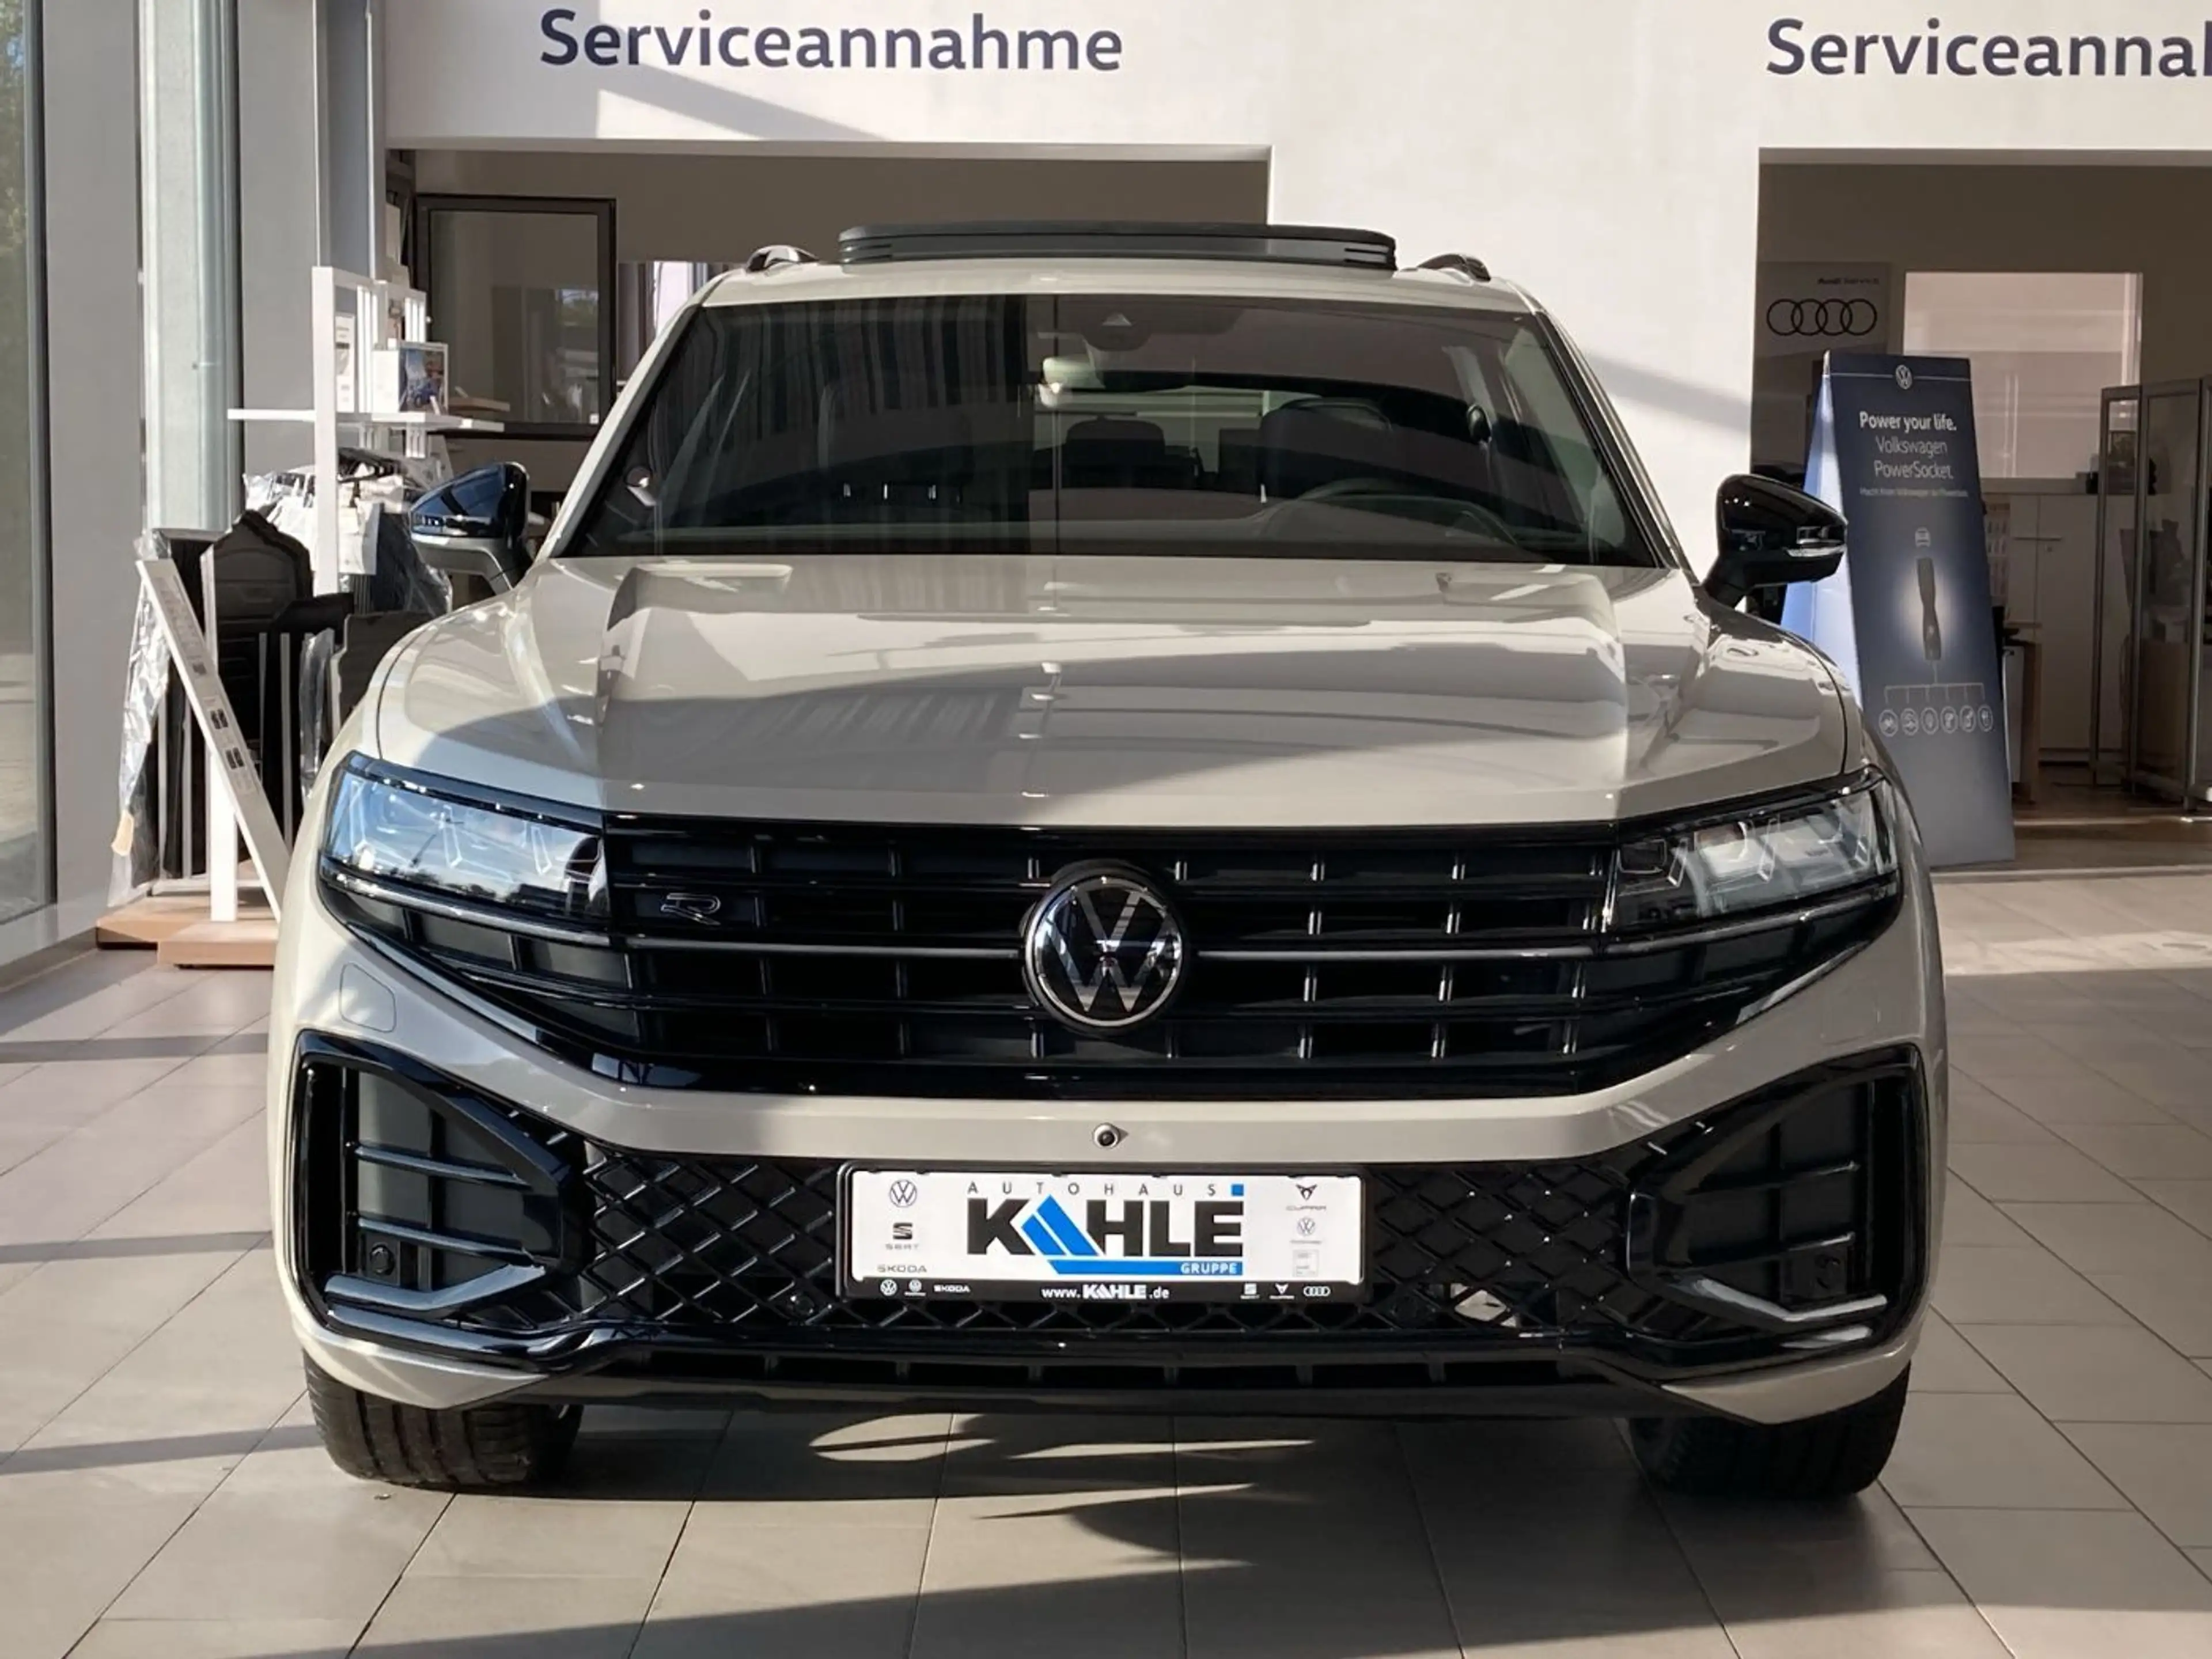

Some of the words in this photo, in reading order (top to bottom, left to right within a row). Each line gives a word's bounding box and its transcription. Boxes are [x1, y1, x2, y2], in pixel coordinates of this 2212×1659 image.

[540, 9, 1123, 71] Serviceannahme
[1859, 411, 1901, 429] Power
[1903, 416, 1931, 434] your
[1933, 413, 1957, 431] life.
[1875, 435, 1948, 459] Volkswagen
[968, 1181, 1216, 1196] AUTOHAUS
[967, 1195, 1244, 1257] KAHLE
[1180, 1263, 1238, 1275] GRUPPE
